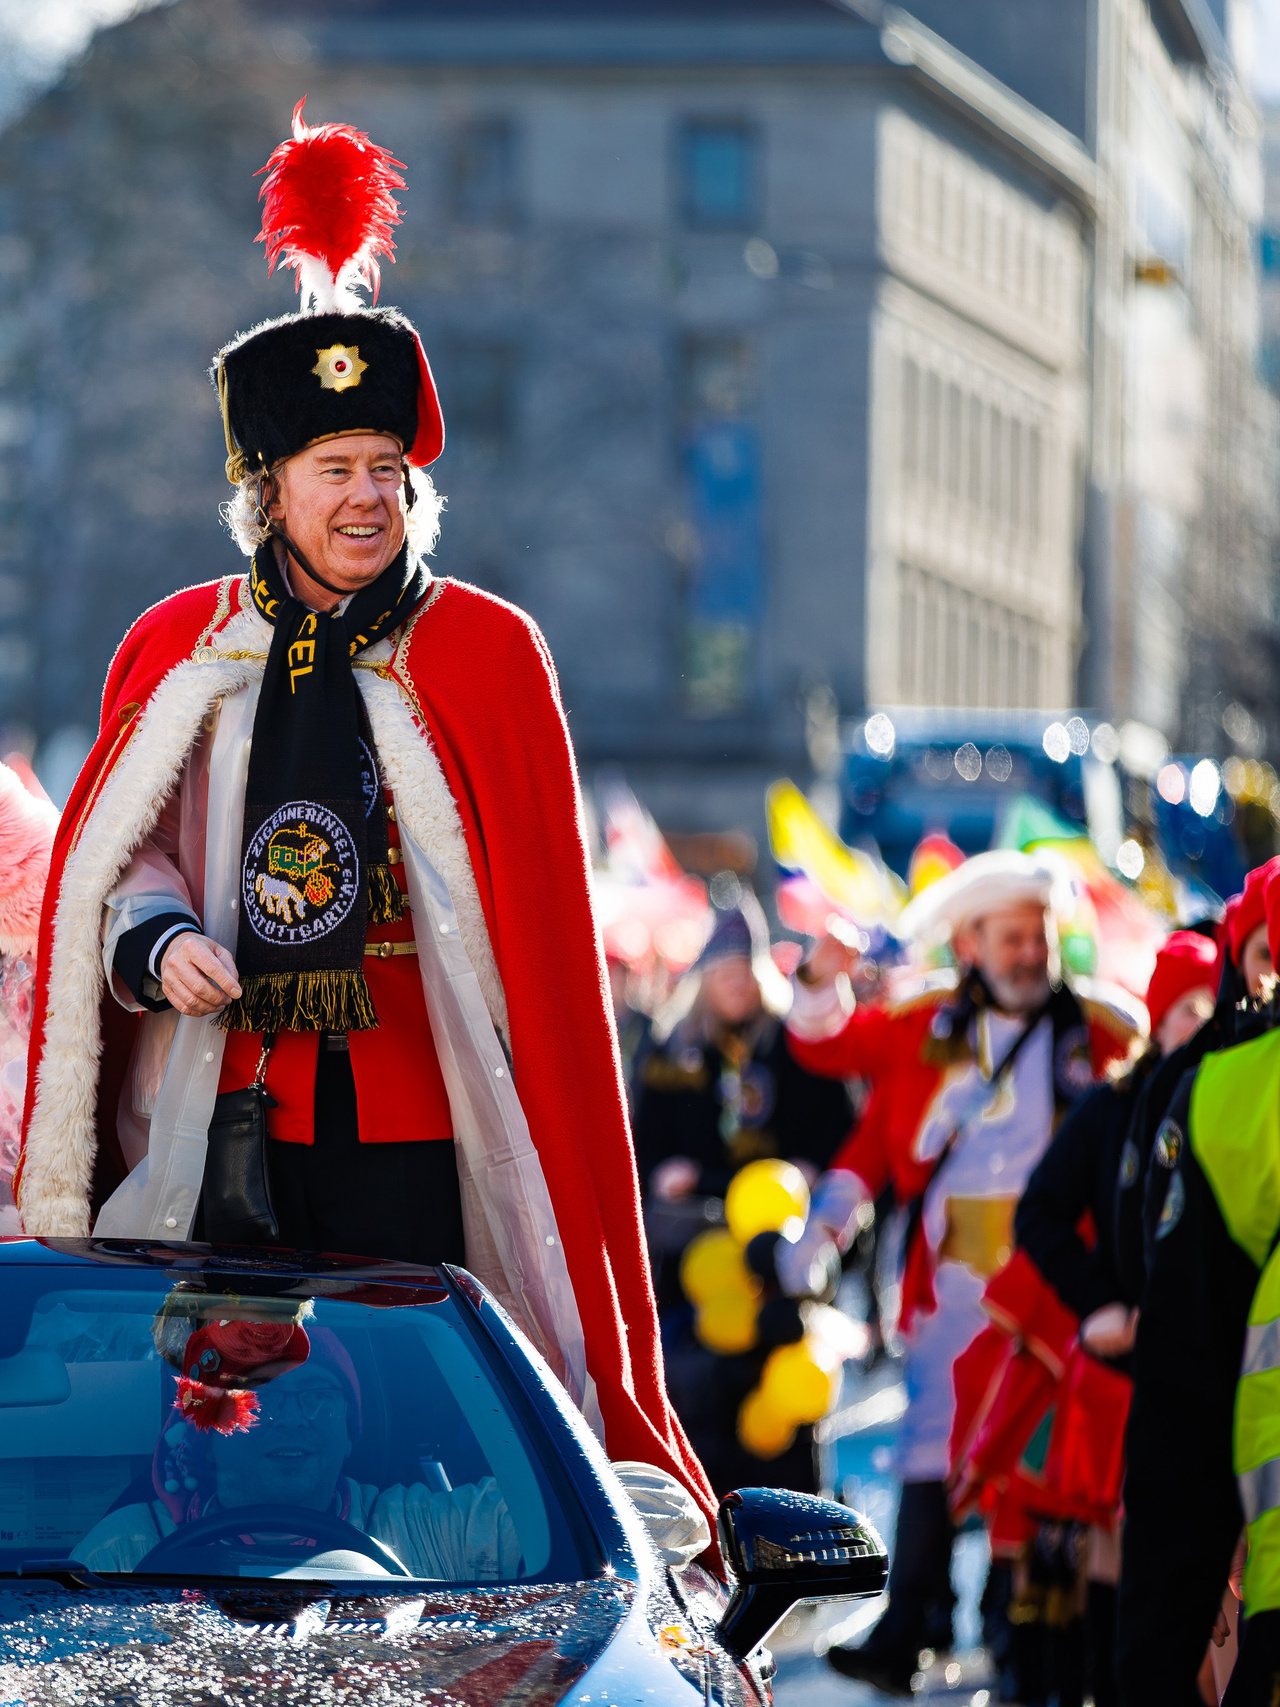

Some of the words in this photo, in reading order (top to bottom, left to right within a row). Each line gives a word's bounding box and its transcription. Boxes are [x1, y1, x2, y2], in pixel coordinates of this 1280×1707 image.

[251, 806, 351, 864] ZIGEUNERINSEL
[251, 901, 345, 940] STUTTGART
[0, 1529, 14, 1541] kg
